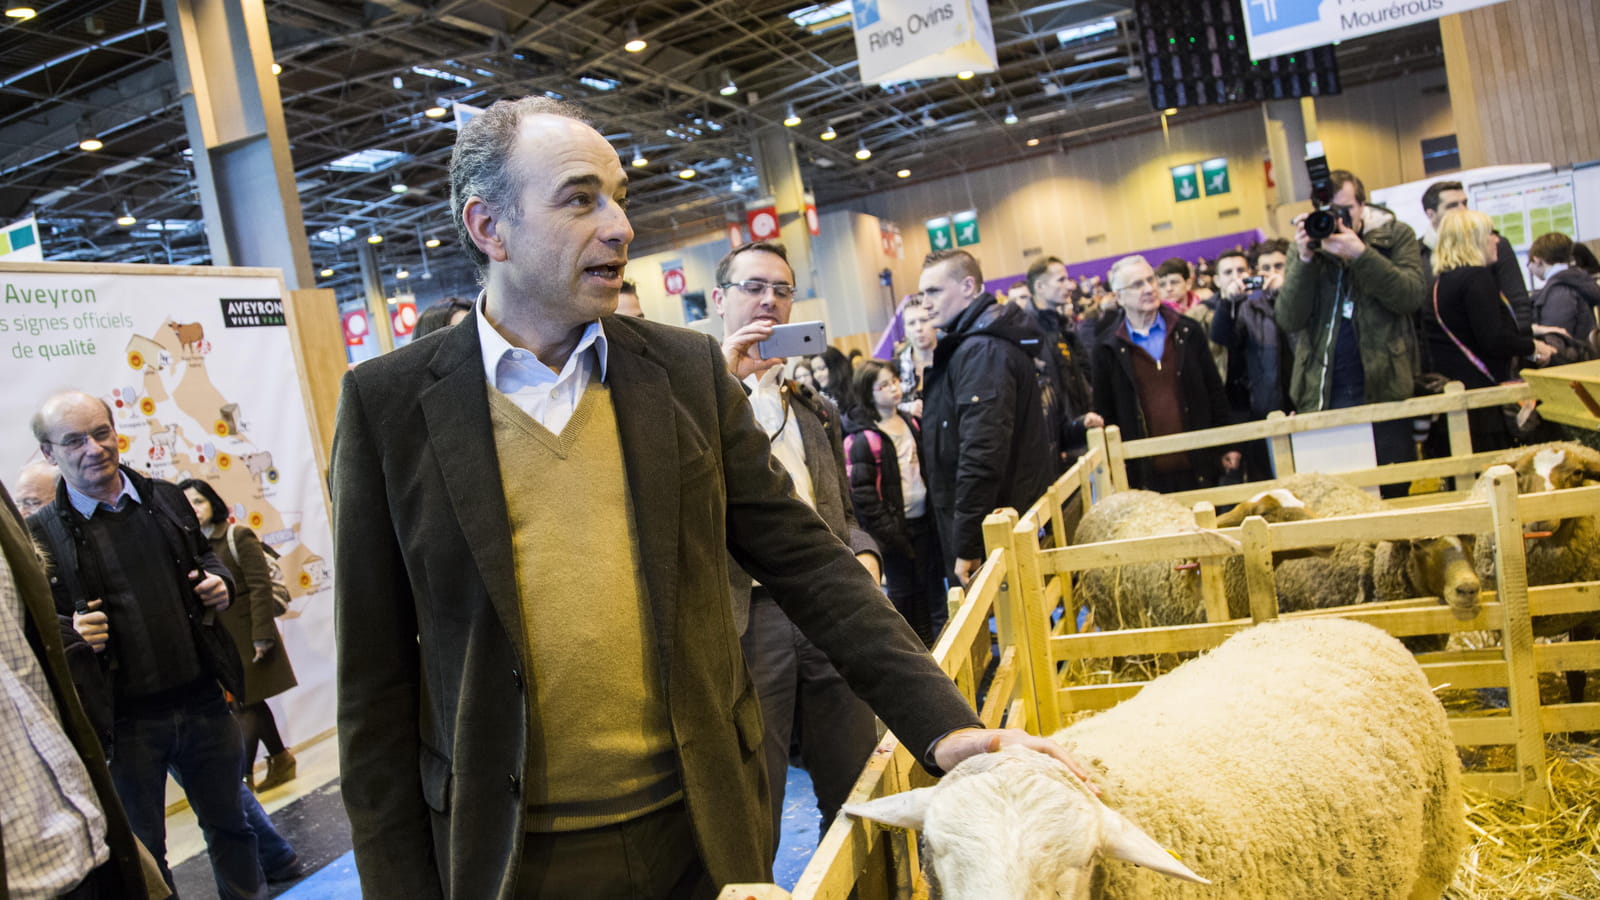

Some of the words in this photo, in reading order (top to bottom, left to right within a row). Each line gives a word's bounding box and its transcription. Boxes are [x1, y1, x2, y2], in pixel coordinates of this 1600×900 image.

[868, 27, 904, 52] Ring
[906, 3, 954, 35] Ovins
[1340, 0, 1444, 30] Mourérous
[5, 283, 97, 309] Aveyron
[227, 301, 284, 315] AVEYRON
[13, 313, 69, 336] signes
[72, 311, 134, 329] officiels
[231, 315, 260, 325] VIVRE
[11, 341, 34, 359] de
[38, 338, 97, 361] qualité
